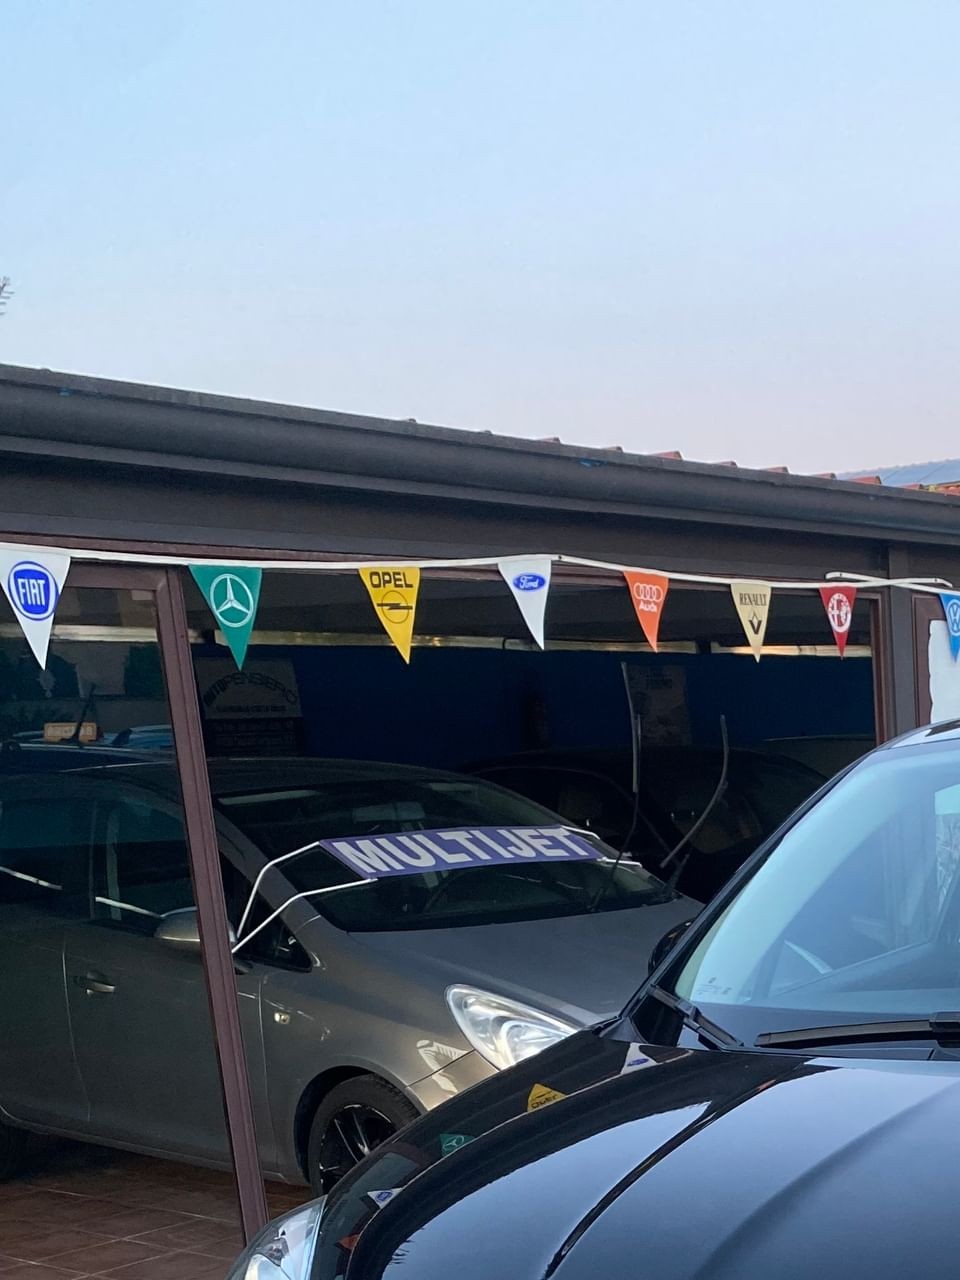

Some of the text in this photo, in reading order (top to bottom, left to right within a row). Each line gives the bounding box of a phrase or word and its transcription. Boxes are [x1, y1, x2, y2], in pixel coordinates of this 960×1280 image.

[369, 571, 414, 588] OPEL
[519, 575, 540, 589] Ford
[15, 577, 47, 606] FIAT
[739, 592, 767, 607] RENAULT
[639, 600, 657, 613] Audi
[331, 826, 590, 874] MULTIJET
